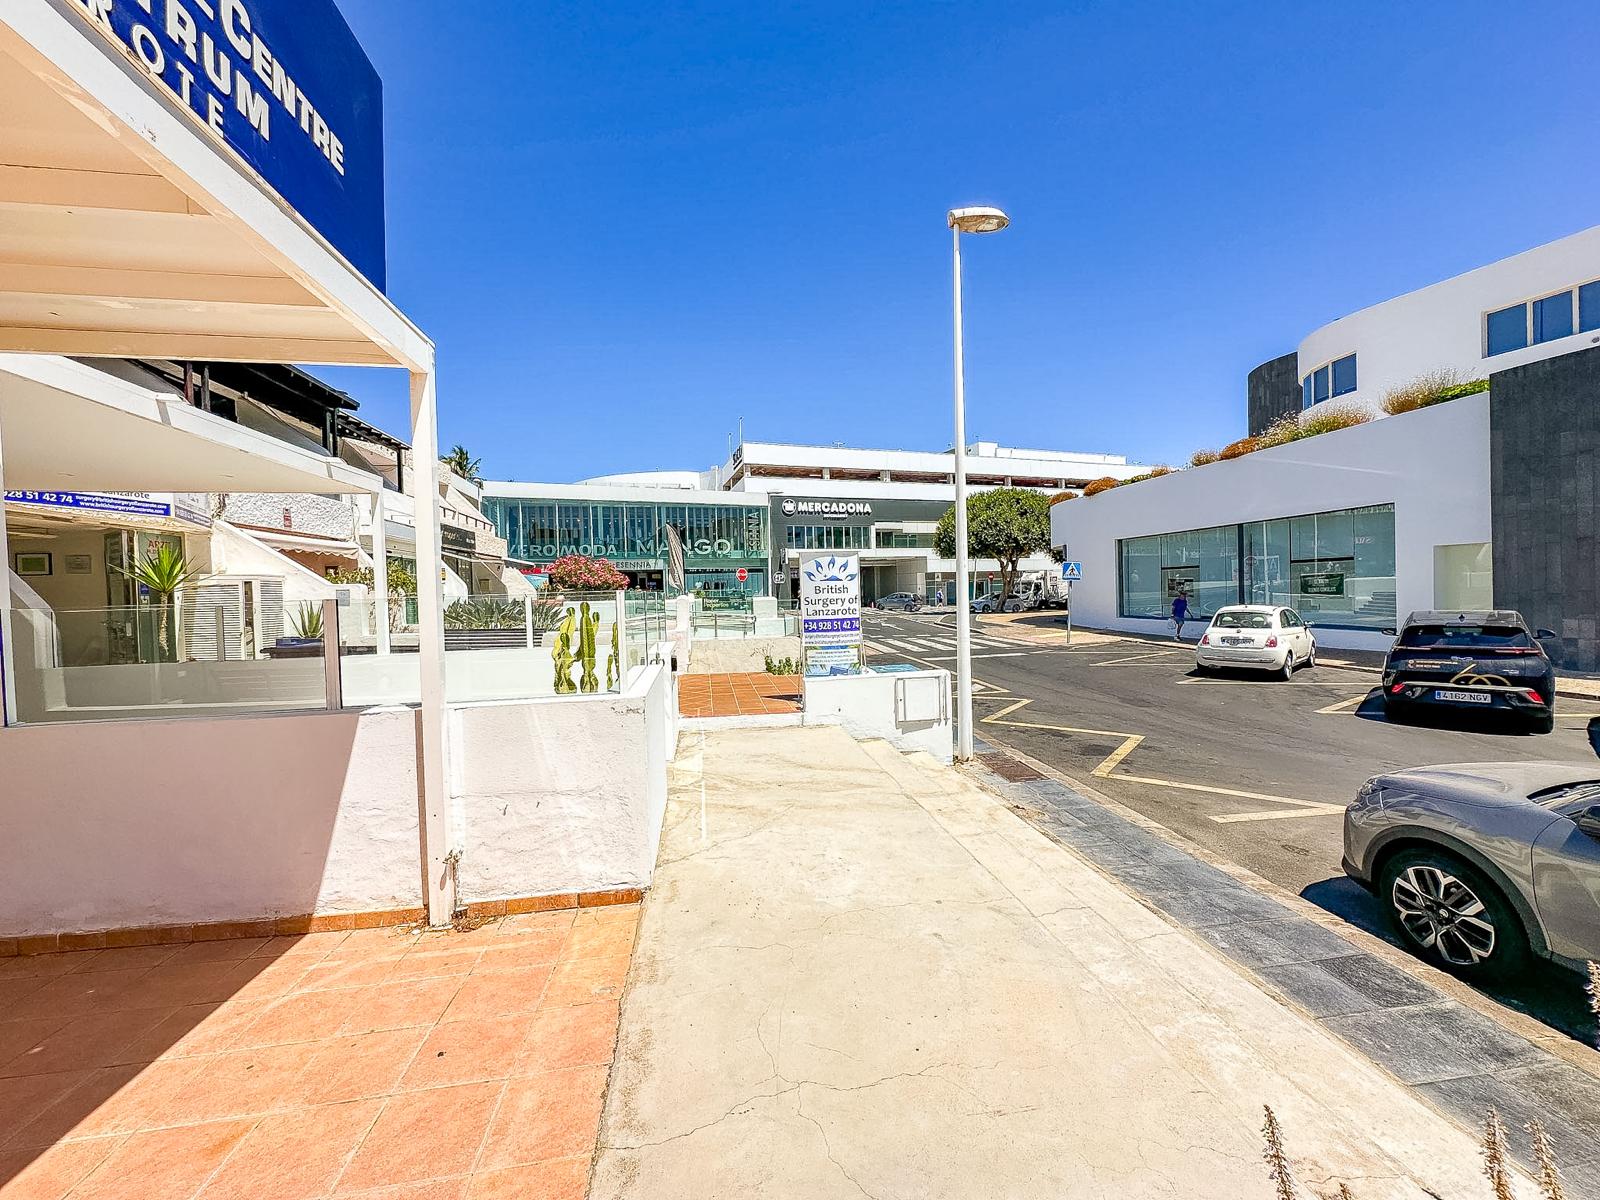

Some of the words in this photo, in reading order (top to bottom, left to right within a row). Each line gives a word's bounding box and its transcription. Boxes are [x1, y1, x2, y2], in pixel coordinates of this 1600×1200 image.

[137, 0, 270, 141] RUM
[220, 0, 345, 176] CENTRE
[26, 491, 39, 499] 51
[42, 493, 57, 502] 42
[60, 494, 73, 503] 74
[797, 501, 872, 513] MERCADONA
[814, 585, 849, 595] British
[804, 596, 846, 608] Surgery
[848, 595, 858, 605] of
[806, 607, 858, 617] Lanzarote
[804, 621, 817, 630] +34
[819, 621, 832, 630] 928
[833, 620, 841, 629] 51
[843, 620, 851, 629] 42
[1442, 693, 1467, 701] 4162
[1469, 694, 1488, 702] NGV
